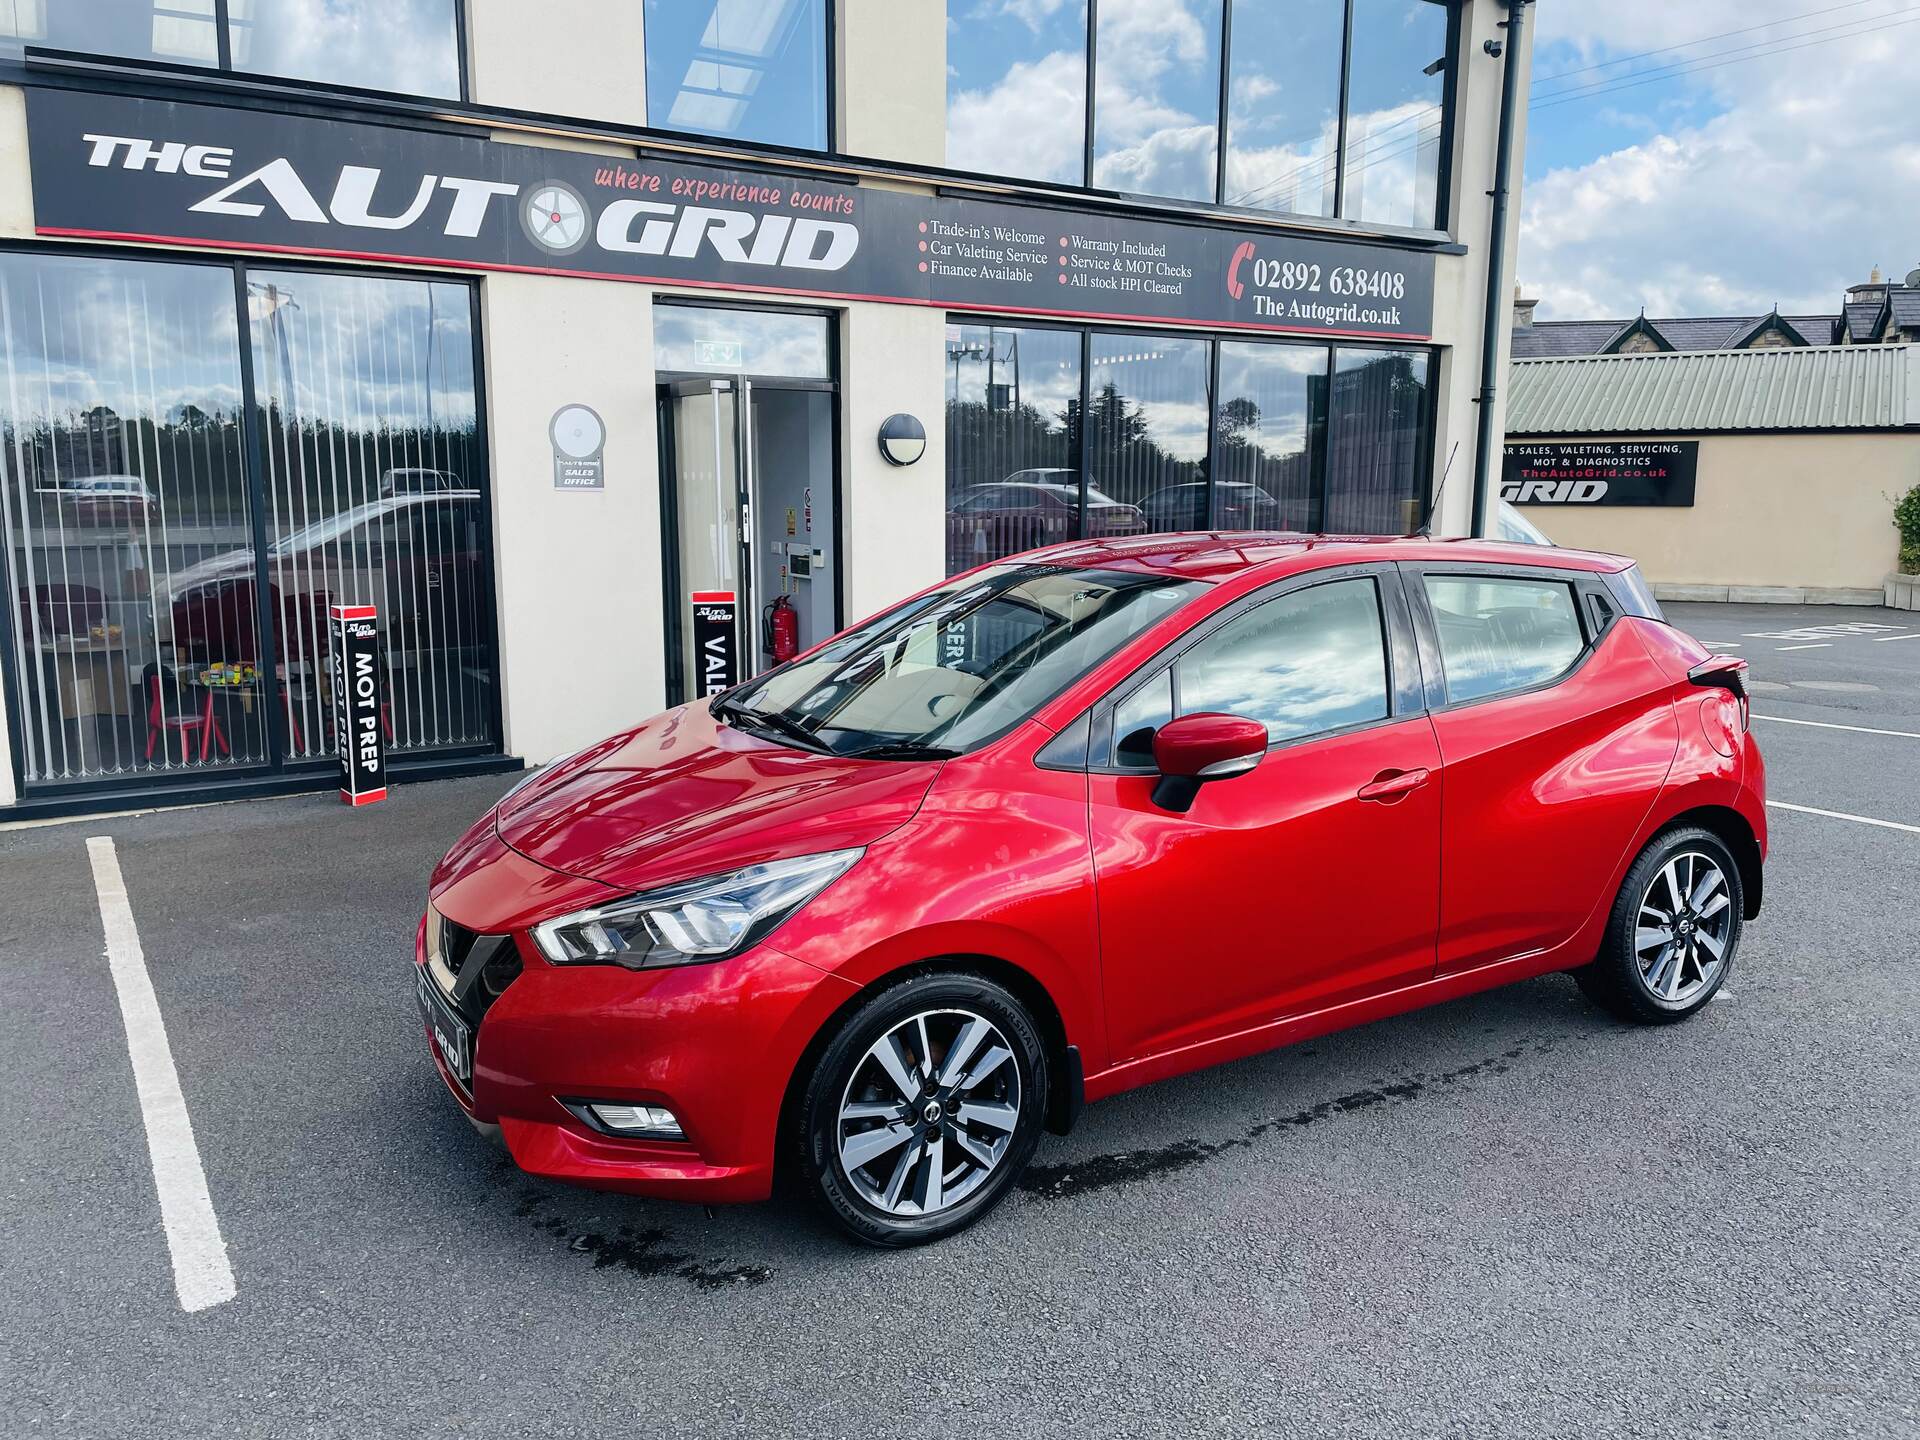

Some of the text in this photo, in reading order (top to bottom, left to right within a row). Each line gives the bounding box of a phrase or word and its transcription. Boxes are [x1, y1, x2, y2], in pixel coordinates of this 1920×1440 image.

[82, 133, 234, 179] THE
[594, 165, 854, 215] where experience counts
[596, 199, 859, 271] GRID
[993, 227, 1046, 245] Welcome
[1071, 235, 1166, 257] Warranty Included
[930, 241, 1048, 265] Car Valeting Service
[1070, 254, 1192, 278] Service & MOT Checks
[930, 261, 1033, 282] Finance Available
[1070, 273, 1182, 295] All stock HPI Cleared
[1253, 258, 1405, 299] 02892 638408
[1253, 295, 1401, 326] The Autogrid.co.uk
[1502, 444, 1682, 456] AR SALES, VALETING, SERVICING,
[1533, 457, 1651, 467] MOT & DIAGNOSTICS
[355, 652, 375, 710] MOT
[358, 716, 379, 774] PREP
[434, 1025, 459, 1068] GRID
